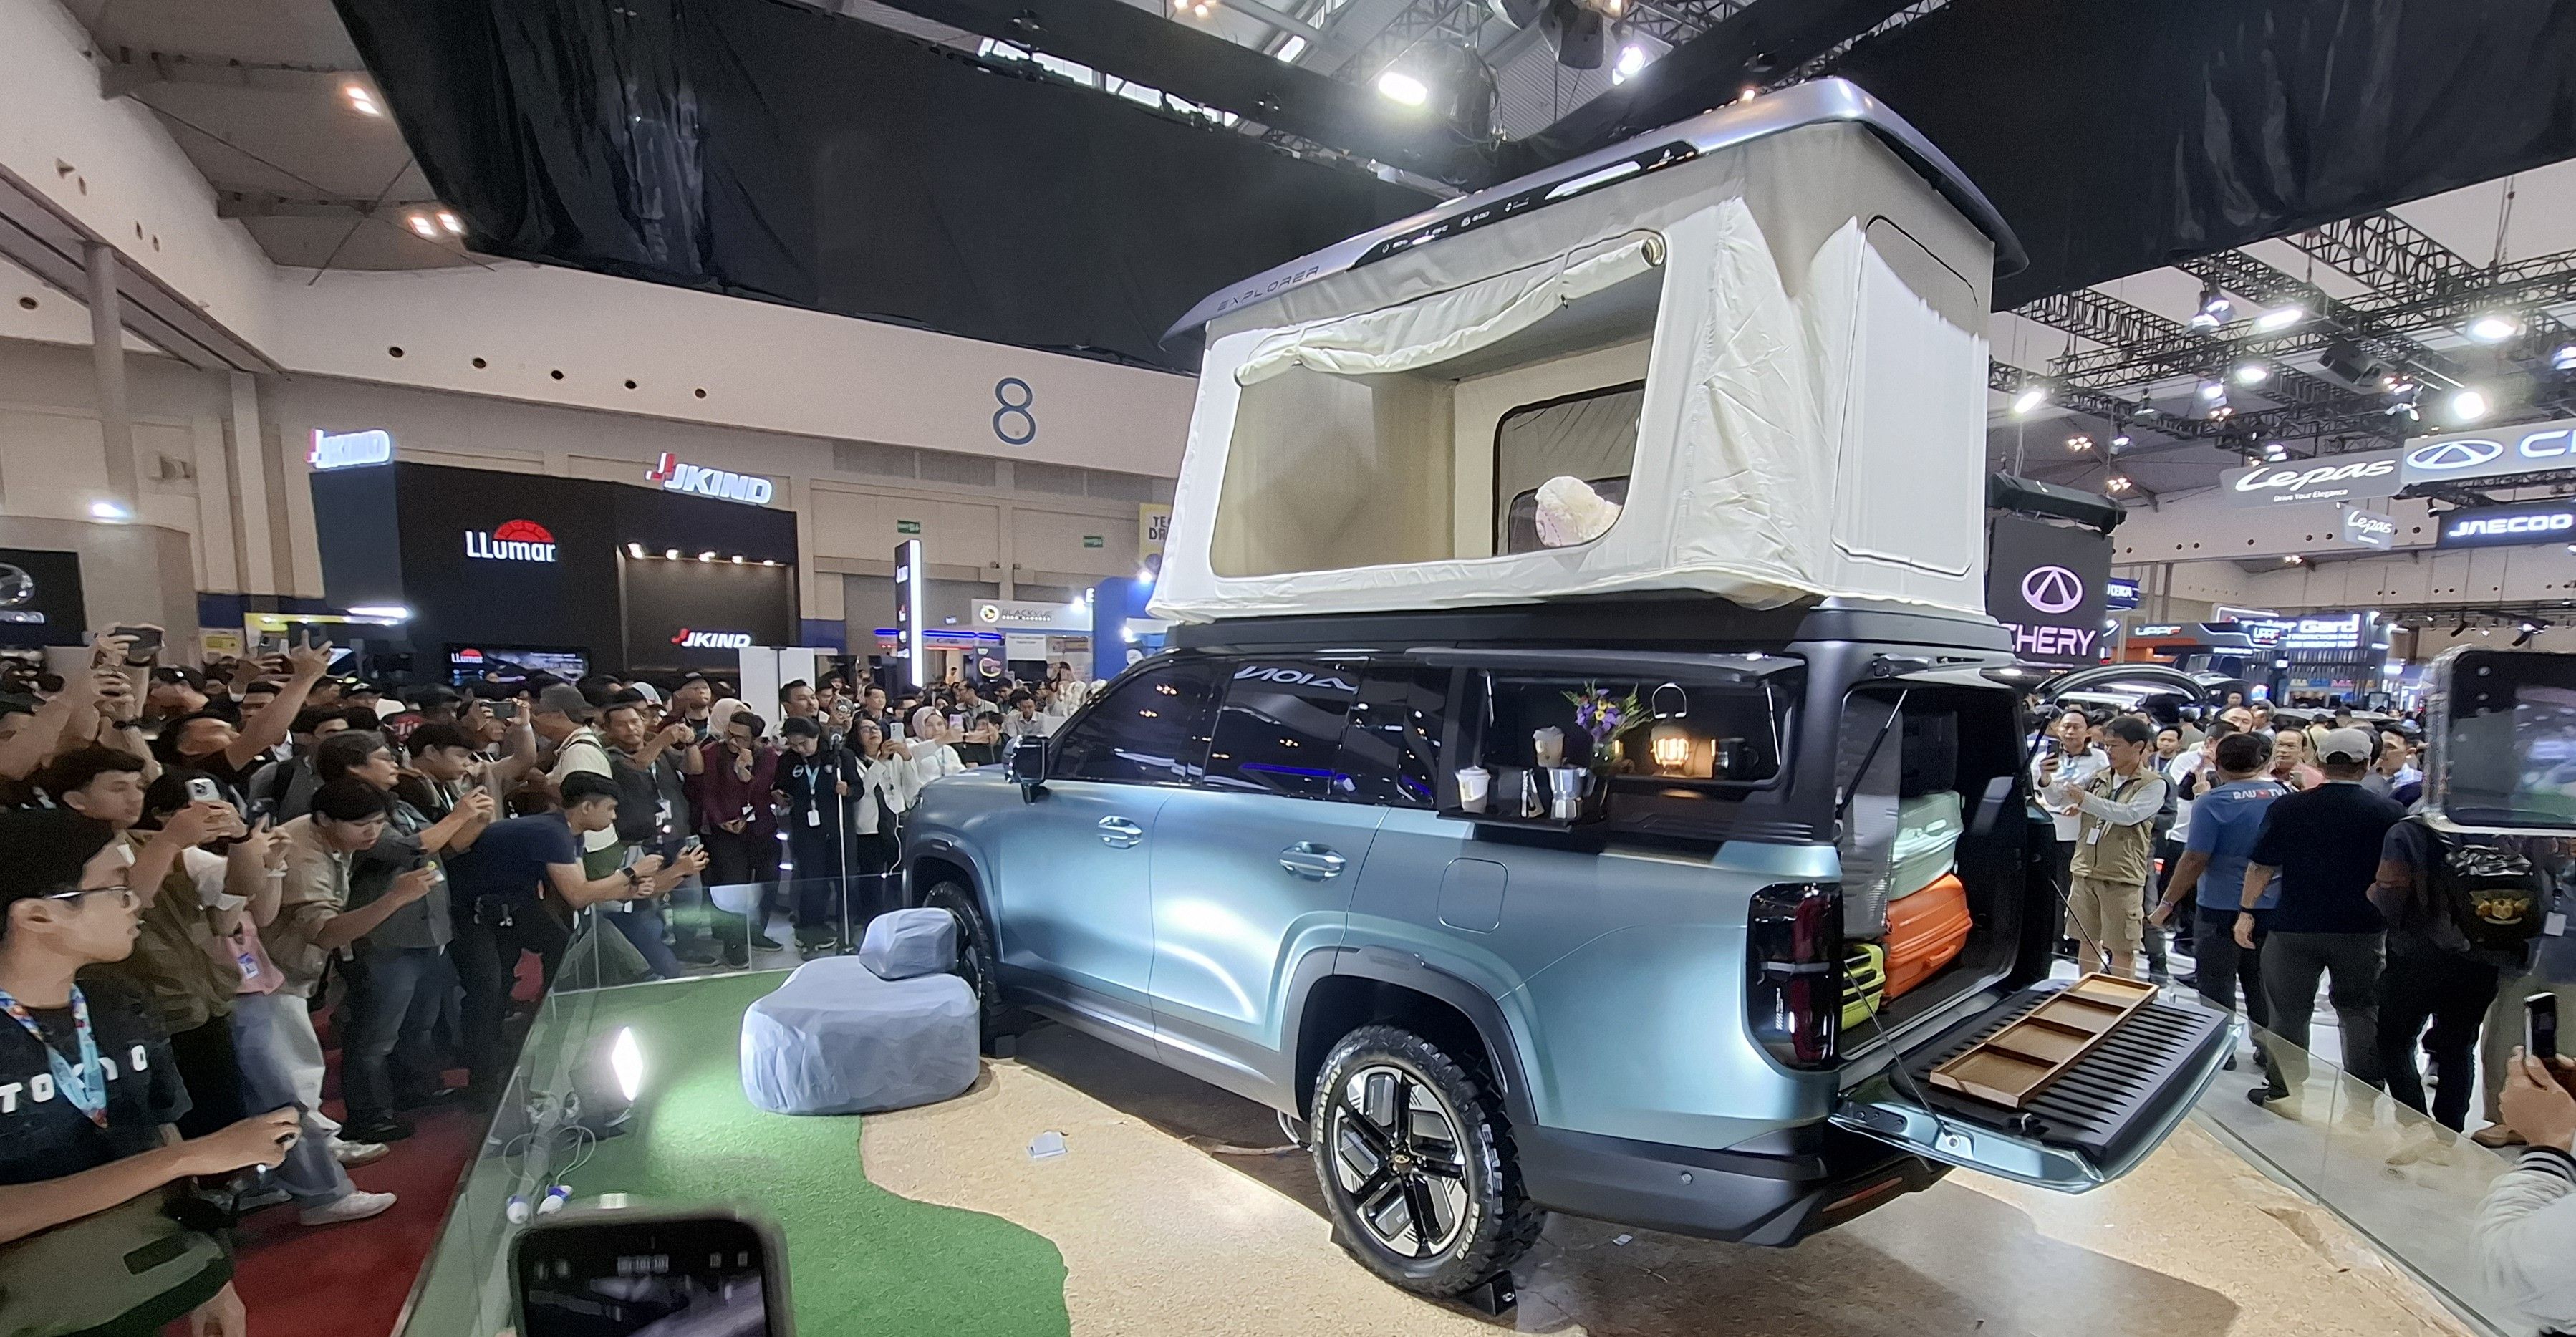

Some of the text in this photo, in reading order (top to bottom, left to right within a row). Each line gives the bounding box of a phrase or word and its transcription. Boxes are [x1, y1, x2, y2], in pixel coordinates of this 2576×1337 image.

[1217, 265, 1320, 312] EXPLORER
[992, 377, 1036, 445] 8
[2235, 459, 2396, 492] Lepas
[2295, 492, 2312, 501] Your
[2312, 488, 2349, 500] Elegance
[2347, 509, 2393, 534] Lepas
[2447, 513, 2575, 537] JAECOO
[465, 530, 557, 563] LLumar
